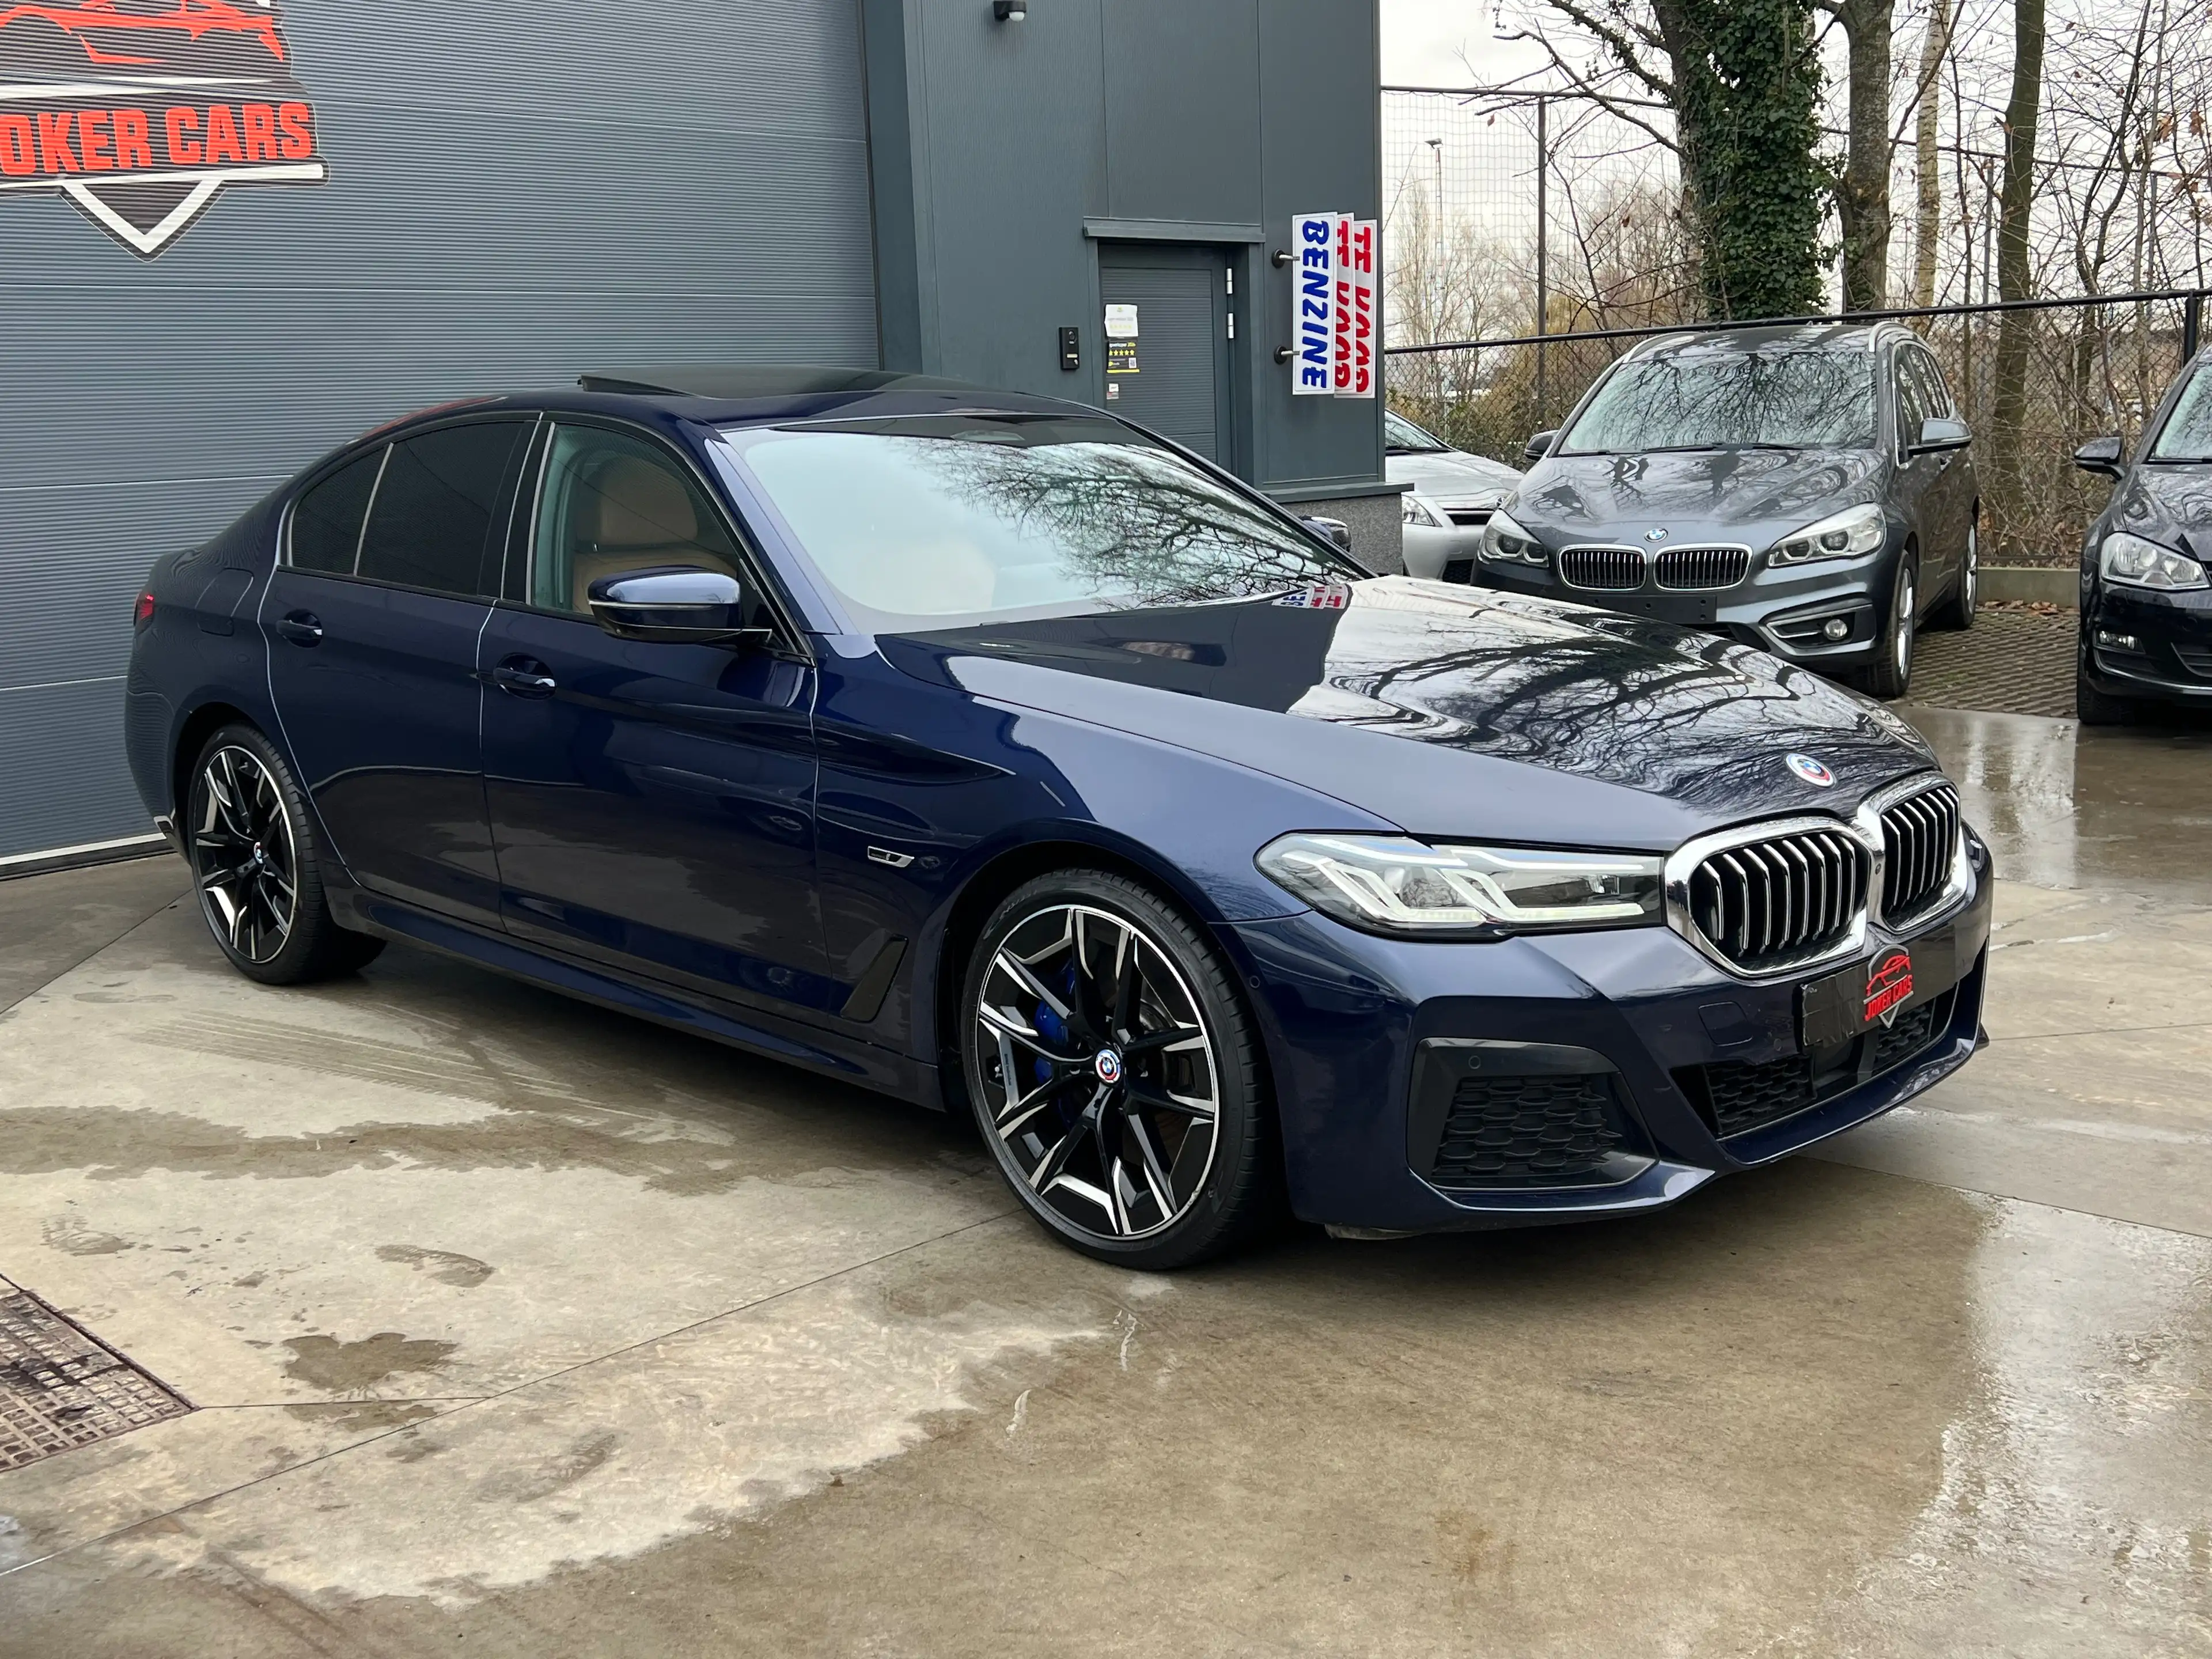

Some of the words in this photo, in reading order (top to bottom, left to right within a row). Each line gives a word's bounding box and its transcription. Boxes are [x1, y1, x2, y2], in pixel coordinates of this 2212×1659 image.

[0, 109, 152, 175] OKER
[165, 103, 312, 164] CARS
[1302, 221, 1329, 388] BENZINE
[1864, 988, 1892, 1021] JOKER
[1893, 974, 1912, 1003] CARS
